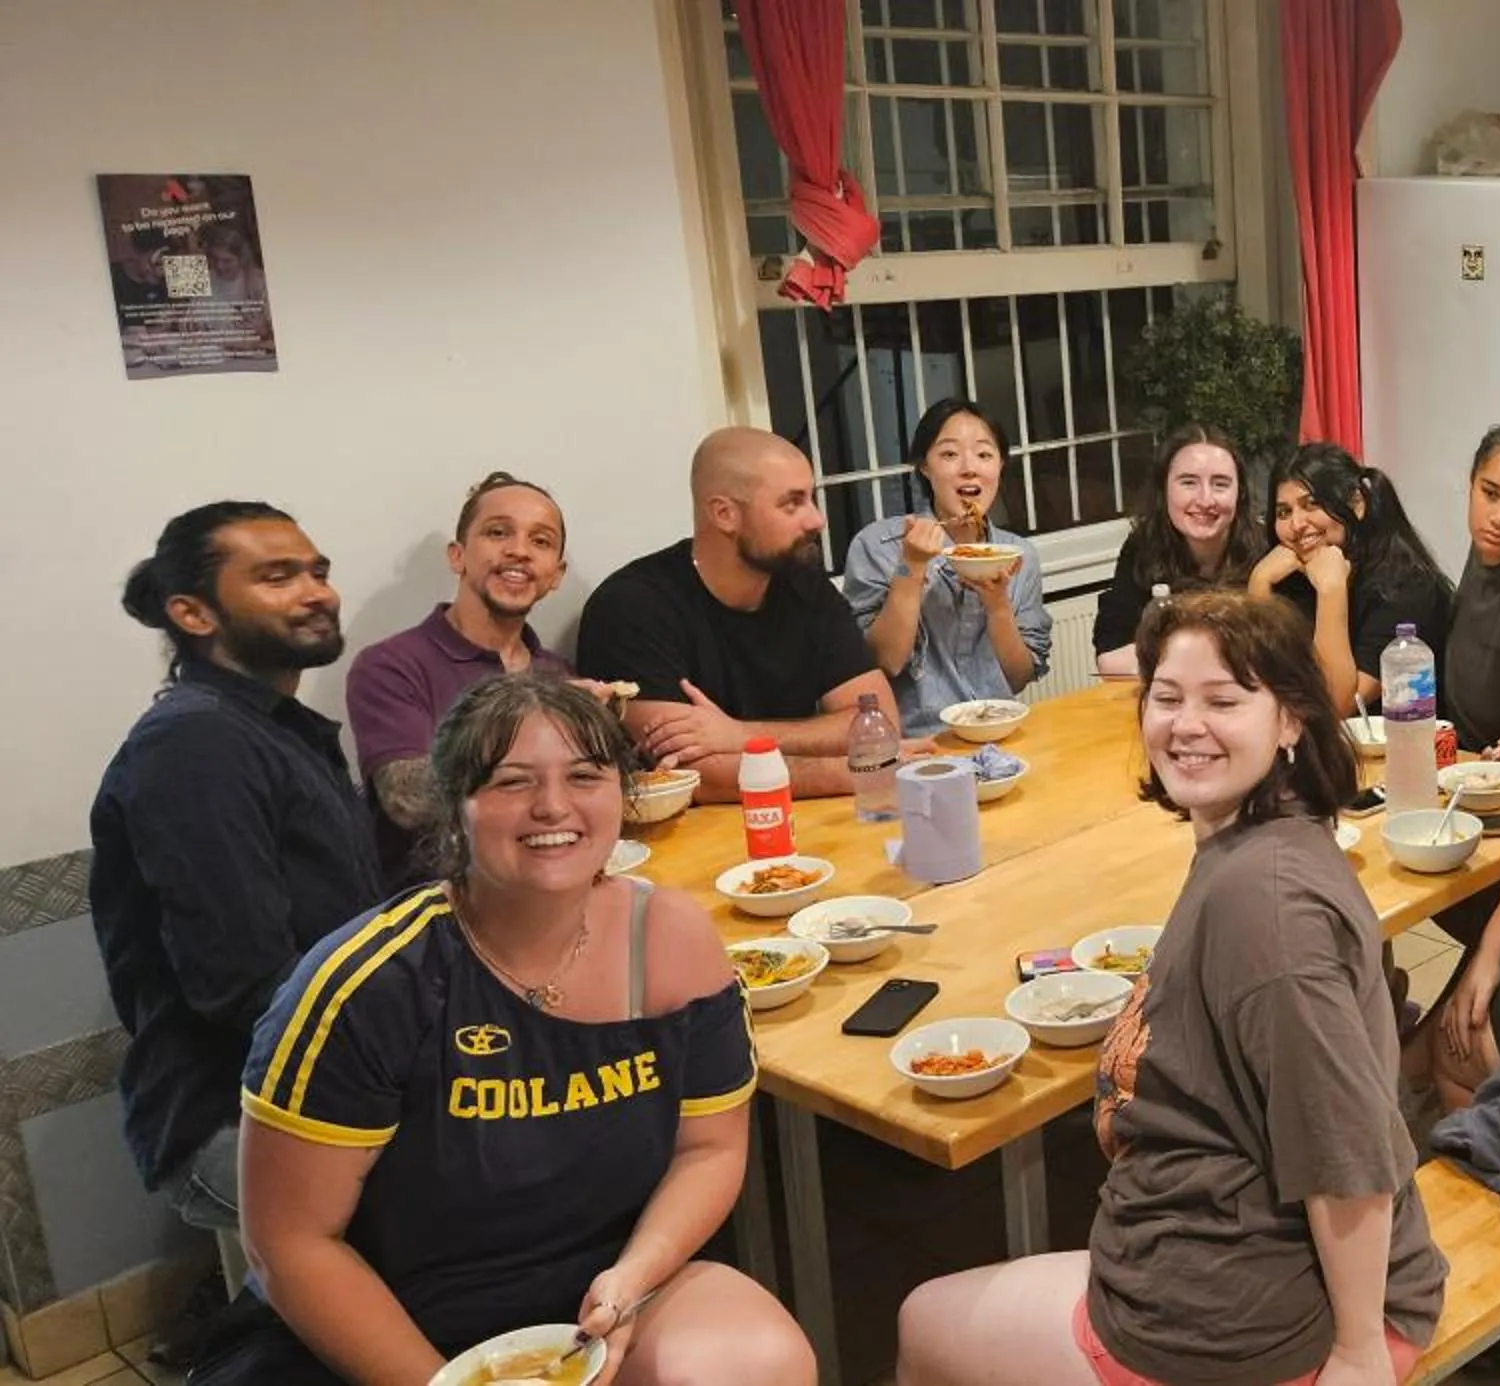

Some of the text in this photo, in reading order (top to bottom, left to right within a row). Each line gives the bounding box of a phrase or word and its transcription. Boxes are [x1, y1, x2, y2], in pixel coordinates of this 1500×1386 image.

[141, 207, 158, 219] Do
[121, 222, 134, 233] to
[448, 1050, 661, 1120] COOLANE
